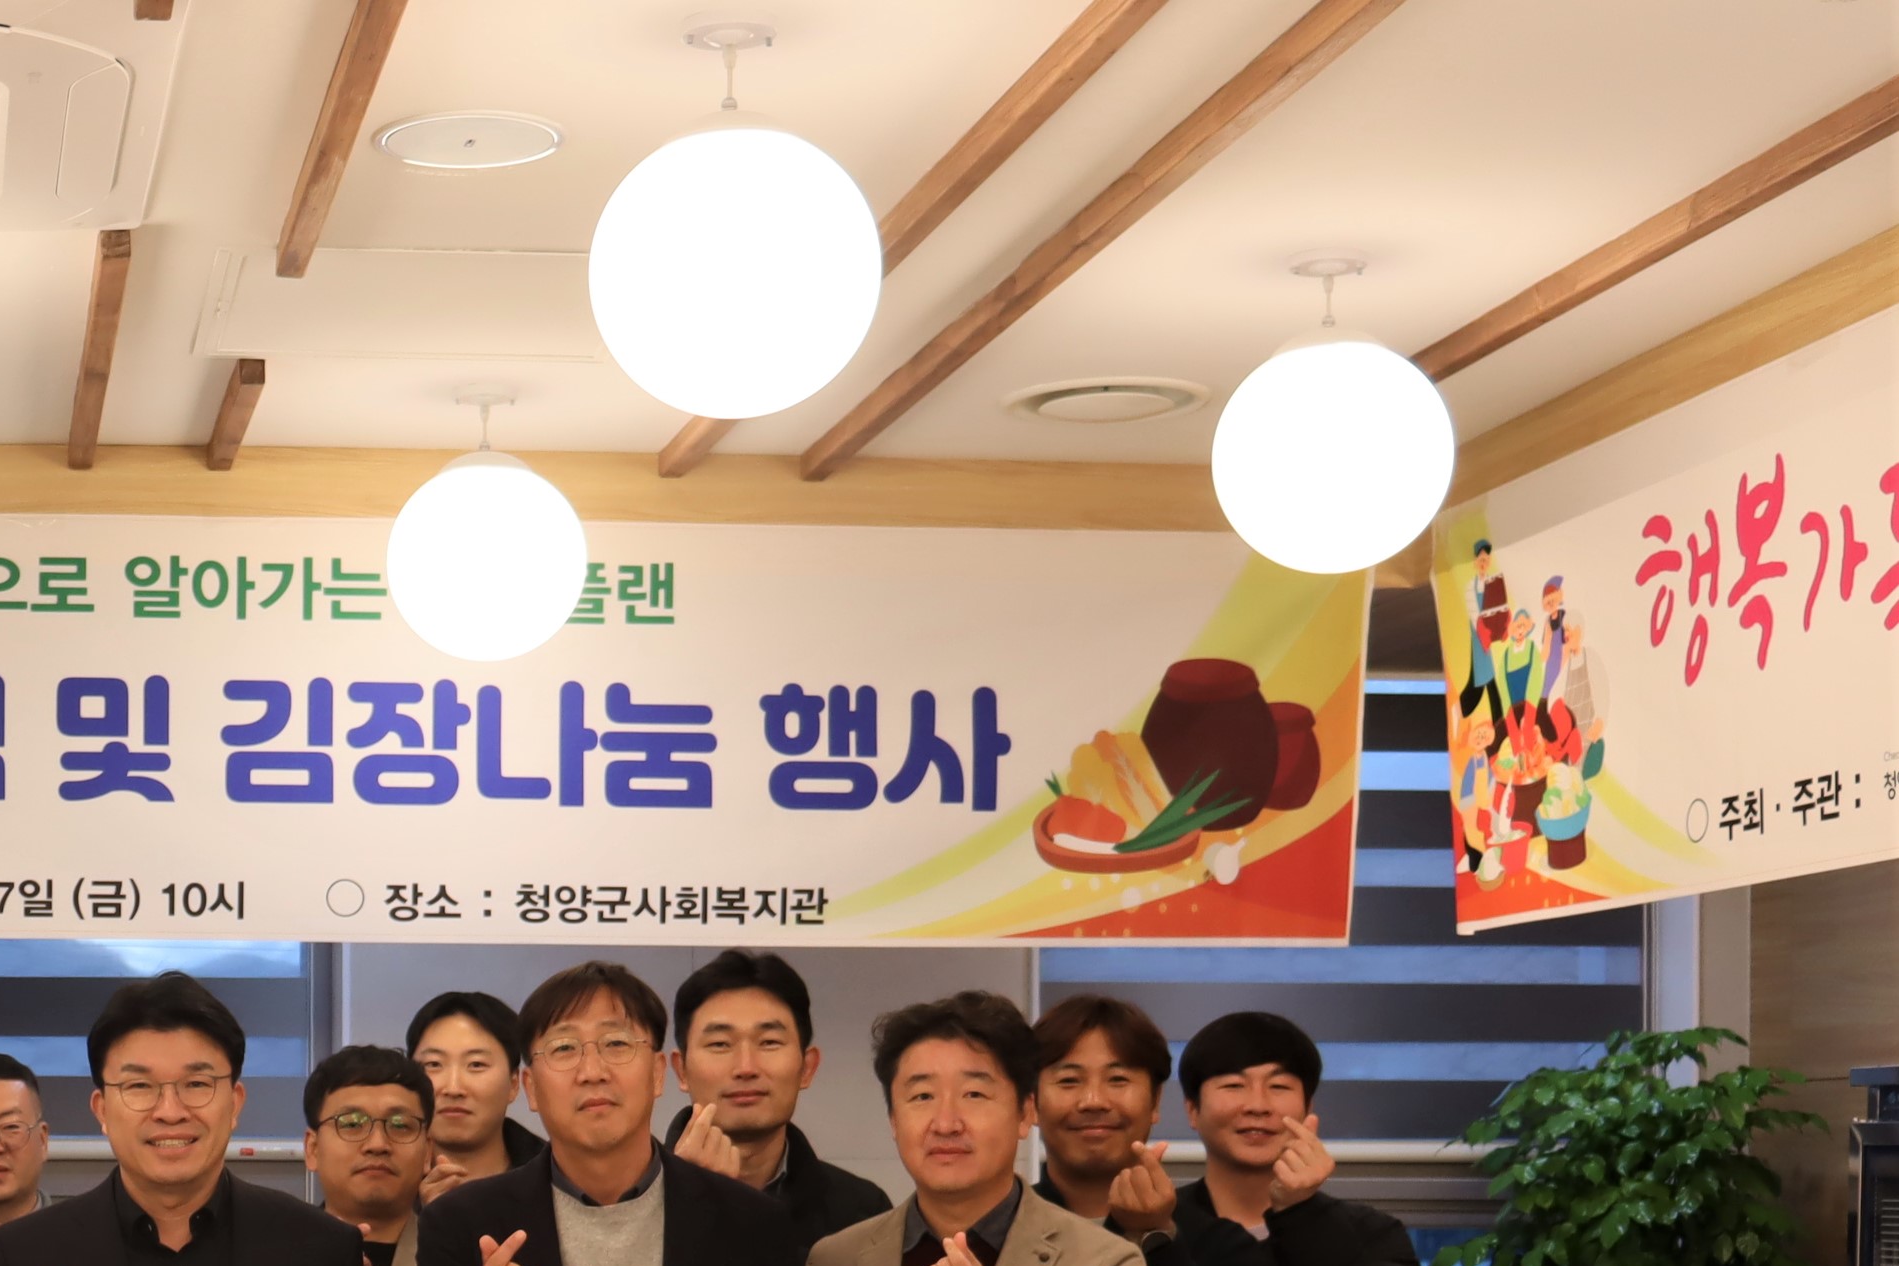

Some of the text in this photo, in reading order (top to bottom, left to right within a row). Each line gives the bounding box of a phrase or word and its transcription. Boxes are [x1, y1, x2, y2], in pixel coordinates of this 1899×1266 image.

[124, 555, 387, 620] 알아가는
[564, 562, 675, 624] 플랜
[56, 675, 174, 802] 및
[221, 677, 717, 808] 김장나눔
[760, 683, 1011, 811] 행사
[1720, 788, 1763, 840] 주최
[1793, 771, 1842, 825] 주관
[73, 878, 140, 920] (금)
[162, 881, 244, 919] 10시
[385, 883, 461, 921] 장소
[516, 884, 828, 925] 청양군사회복지관
